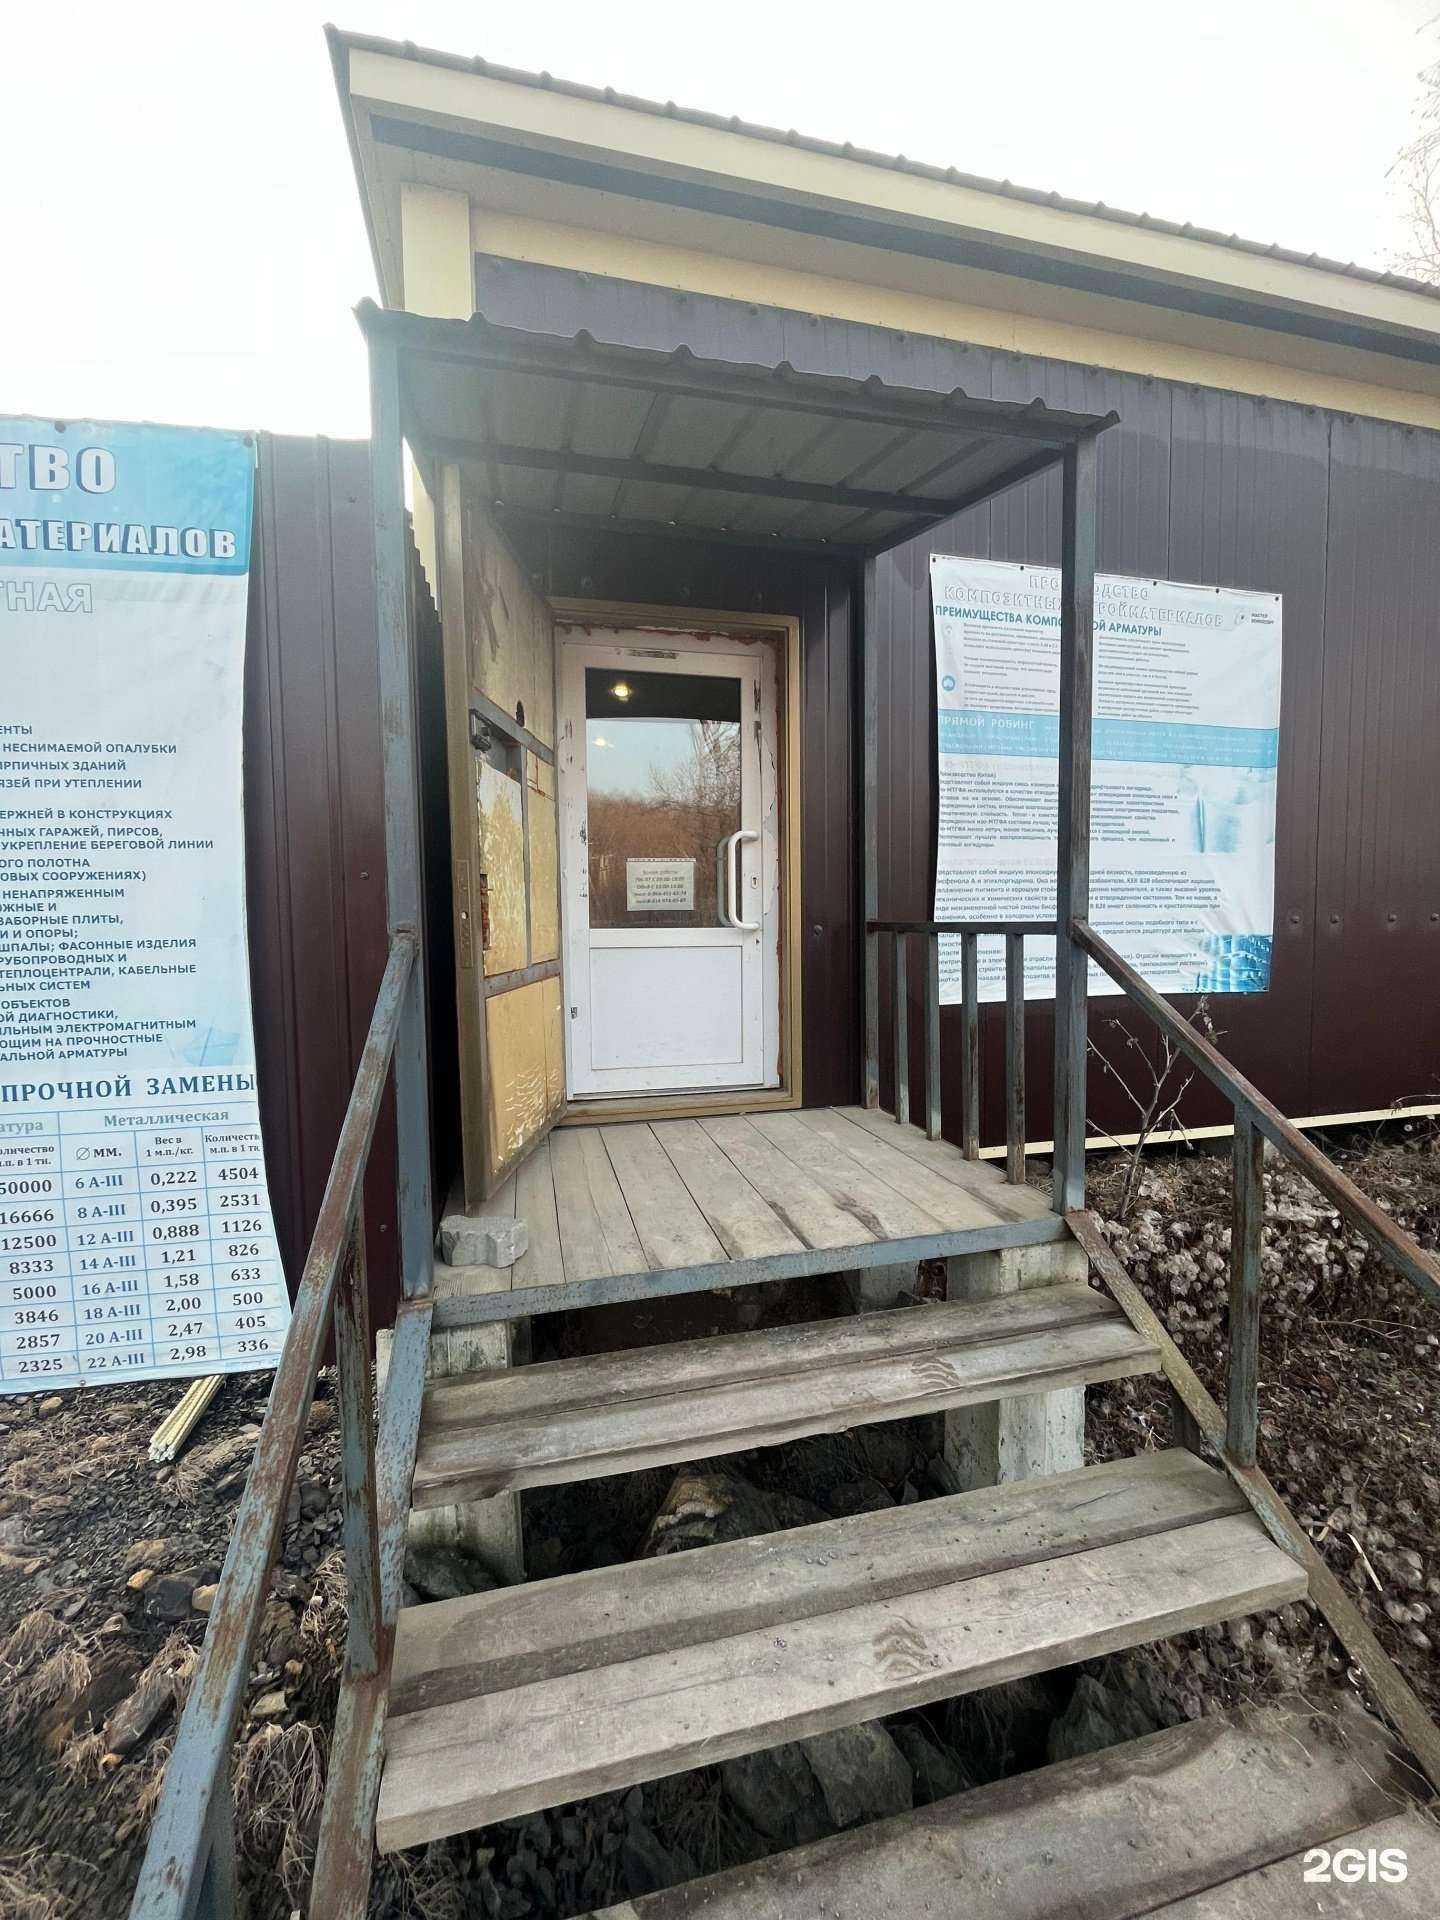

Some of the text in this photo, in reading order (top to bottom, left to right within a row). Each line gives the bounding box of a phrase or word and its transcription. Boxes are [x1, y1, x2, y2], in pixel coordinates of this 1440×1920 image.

[0, 580, 93, 613] НАЯ
[935, 605, 1022, 624] ПРЕИМУЩЕСТВА
[1109, 623, 1161, 636] АРМАТУРЫ
[3, 742, 177, 754] НЕСНИМАЕМОЙ ОПАЛУБКИ
[72, 760, 126, 772] ЗДАНИЙ
[34, 779, 61, 788] ПРИ
[64, 779, 142, 789] УТЕПЛЕНИИ
[0, 808, 173, 820] ЕРЖНЕЙ В КОНСТРУКЦИЯХ
[39, 826, 103, 838] ГАРАЖЕЙ,
[107, 827, 163, 838] ПИРСОВ,
[1, 838, 214, 850] УКРЕПЛЕНИЕ БЕРЕГОВОЙ ЛИНИИ
[0, 859, 90, 868] ОГО ПОЛОТНА
[0, 870, 146, 882] ОВЫХ СООРУЖЕНИЯХ)
[2, 889, 125, 899] НЕНАПРЯЖЕННЫМ
[0, 903, 57, 912] ЖНЫЕ И
[72, 915, 124, 925] ПЛИТЫ,
[0, 929, 78, 939] И И ОПОРЫ;
[0, 939, 196, 953] ШПАЛЫ; ФАСОННЫЕ ИЗДЕЛИЯ
[118, 954, 127, 962] И
[118, 965, 197, 975] КАБЕЛЬНЫЕ
[39, 981, 90, 991] СИСТЕМ
[1, 999, 71, 1010] ОБЪЕКТОВ
[19, 1010, 118, 1023] ДИАГНОСТИКИ,
[0, 1020, 196, 1036] ЛЬНЫМ ЭЛЕКТРОМАГНИТНЫМ
[0, 1034, 163, 1050] ОЩИМ НА ПРОЧНОСТНЫЕ
[1, 1048, 128, 1062] АЛЬНОЙ АРМАТУРЫ
[1, 1074, 256, 1102] ПРОЧНОЙ ЗАМЕНЫ
[104, 1110, 229, 1128] Металлическая
[155, 1137, 174, 1145] Вес
[0, 1145, 55, 1155] личество
[146, 1149, 151, 1157] 1
[26, 1158, 32, 1166] 1
[0, 1179, 52, 1195] 50000
[75, 1178, 84, 1189] 6
[150, 1171, 197, 1187] 0,222
[218, 1167, 259, 1181] 4504
[0, 1209, 54, 1225] 16666
[77, 1207, 87, 1219] 8
[151, 1198, 197, 1214] 0,395
[220, 1194, 261, 1208] 2531
[2, 1234, 57, 1251] 12500
[77, 1234, 96, 1246] 12
[152, 1224, 200, 1241] 0,888
[222, 1220, 262, 1233] 1126
[9, 1259, 54, 1275] 8333
[80, 1258, 98, 1270] 14
[161, 1249, 197, 1265] 1,21
[228, 1244, 259, 1257] 826
[13, 1285, 57, 1300] 5000
[82, 1284, 101, 1296] 16
[164, 1273, 200, 1289] 1,58
[231, 1268, 261, 1281] 633
[14, 1309, 59, 1325] 3846
[84, 1308, 103, 1320] 18
[166, 1298, 202, 1312] 2,00
[232, 1292, 263, 1305] 500
[16, 1334, 61, 1349] 2857
[85, 1333, 105, 1345] 20
[168, 1322, 203, 1338] 2,47
[235, 1316, 266, 1329] 405
[18, 1358, 63, 1373] 2325
[87, 1357, 107, 1369] 22
[170, 1346, 207, 1361] 2,98
[238, 1339, 269, 1353] 336
